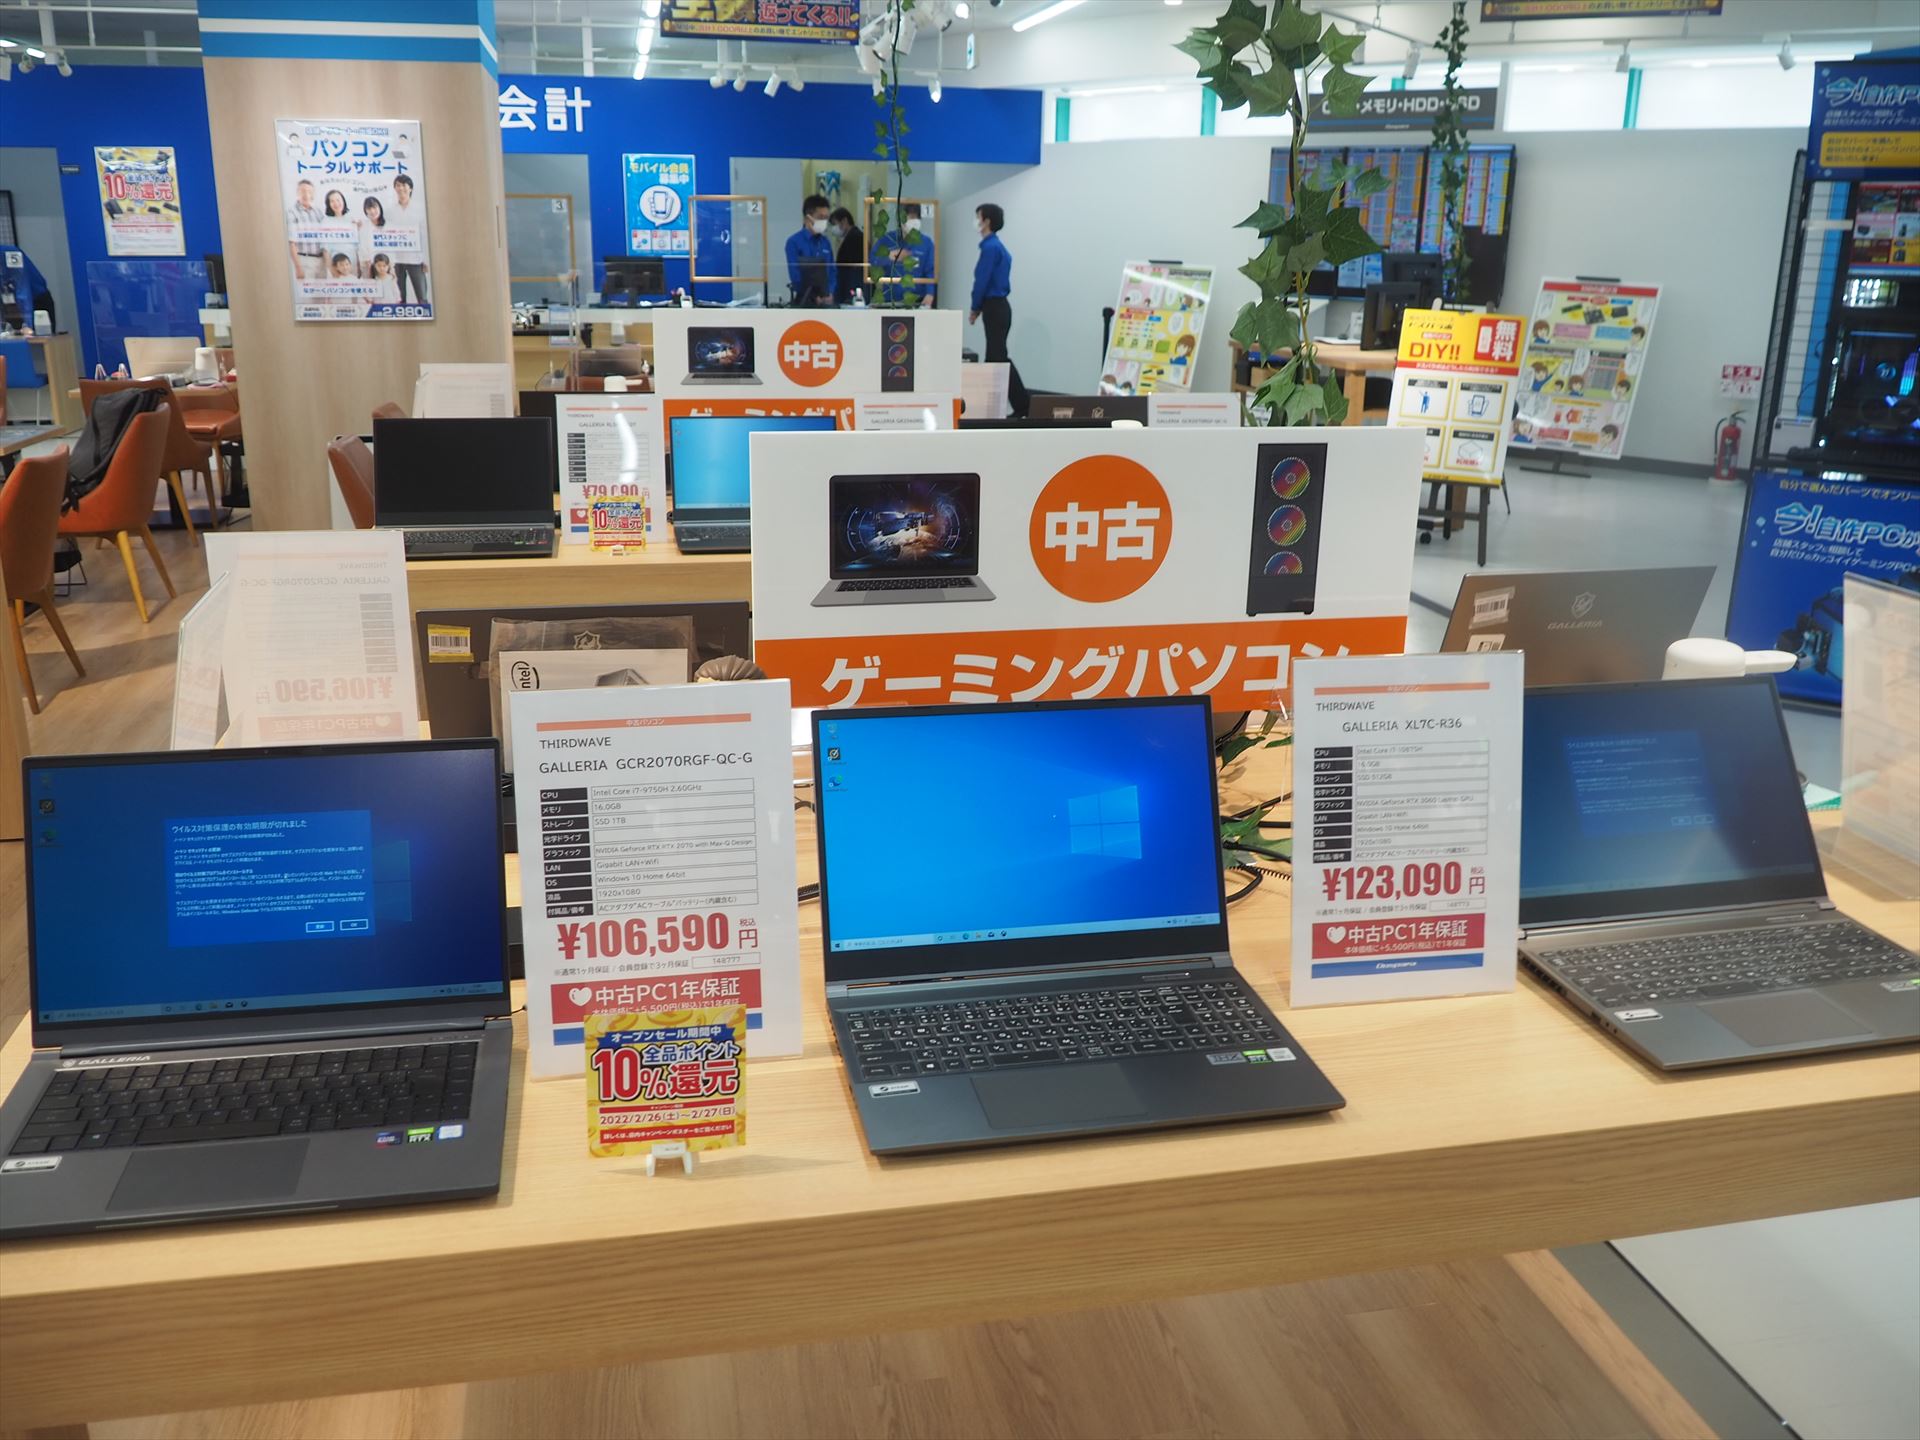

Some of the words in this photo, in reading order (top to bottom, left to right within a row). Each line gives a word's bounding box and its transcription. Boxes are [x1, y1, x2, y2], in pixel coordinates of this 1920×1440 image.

[499, 84, 592, 133] 会計
[311, 138, 390, 158] パソコン
[297, 161, 409, 174] トータルサポート
[630, 162, 689, 174] モバイル会員
[103, 172, 175, 201] 10%還元
[556, 200, 563, 210] 3
[752, 202, 759, 212] 2
[1492, 320, 1518, 362] 無料
[784, 341, 838, 369] 中古
[1409, 342, 1461, 361] DIY!!
[592, 509, 643, 529] 10%還元
[1044, 500, 1160, 562] 中古
[1547, 619, 1603, 631] GALLERIA
[520, 666, 531, 690] ntel
[819, 640, 1350, 710] ゲーミングパソコ
[1316, 701, 1375, 711] THIRDWAVE
[1342, 720, 1399, 732] GALLERIA
[1405, 718, 1462, 730] XL7C-R36
[540, 736, 612, 749] THIRDWAVE
[539, 760, 608, 774] GALLERIA
[616, 752, 753, 770] GCR2070RGF-QC-G
[541, 791, 559, 799] CPU
[593, 789, 611, 797] Intel
[542, 805, 561, 814] メモリ
[172, 820, 308, 833] ウイルス対策保護の有効期限が切れました
[543, 819, 574, 828] ストレージ
[545, 863, 561, 872] LAN
[546, 878, 558, 887] OS
[597, 875, 631, 883] Windows
[1322, 861, 1462, 902] ¥123,090
[1469, 876, 1485, 896] 円
[557, 912, 729, 960] ¥106,590
[739, 928, 758, 950] 円
[1348, 920, 1468, 944] 中古PC1年保証
[595, 977, 741, 1006] 中古PC1年保証
[611, 1026, 722, 1043] オープンセール期間中
[78, 1055, 151, 1066] GALLERIA
[644, 1041, 740, 1063] 全品ポイント
[593, 1048, 738, 1100] 10%還元
